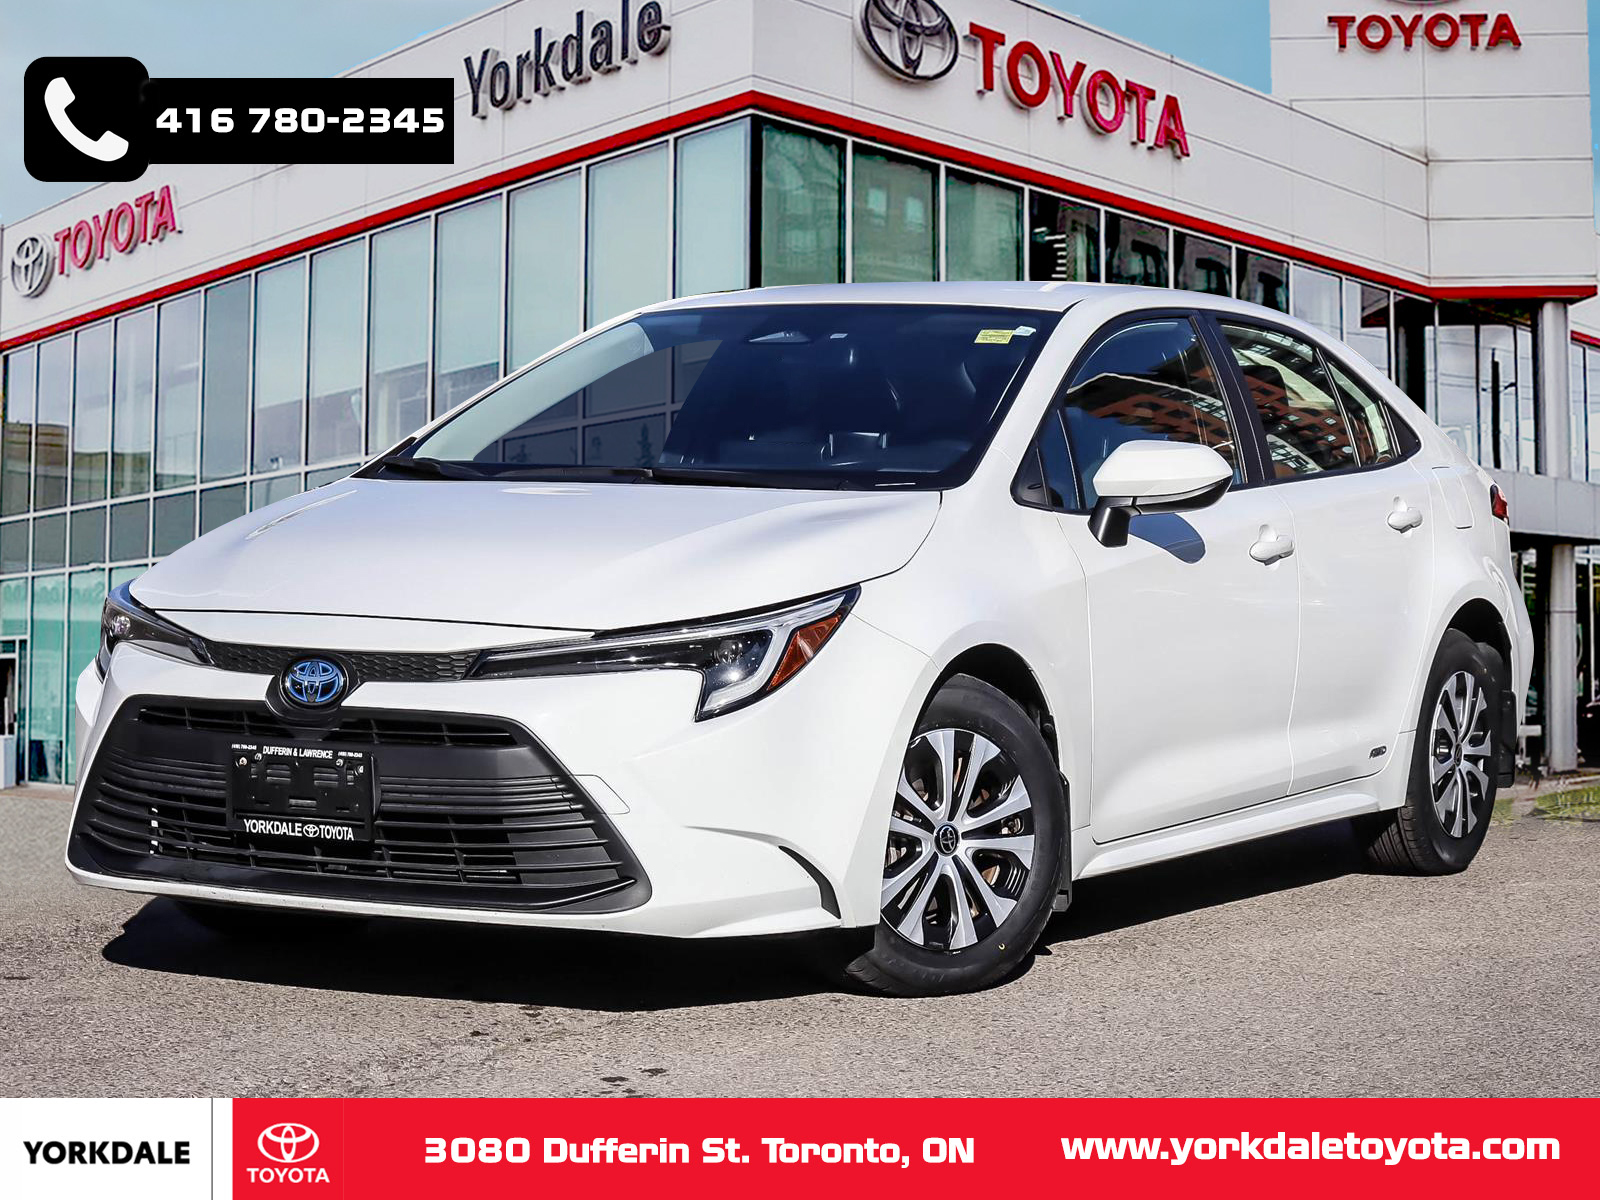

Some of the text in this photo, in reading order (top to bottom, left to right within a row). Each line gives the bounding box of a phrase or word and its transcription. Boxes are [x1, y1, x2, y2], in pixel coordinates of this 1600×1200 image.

[464, 0, 671, 119] Yorkdale
[1327, 13, 1522, 51] TOYOTA
[967, 21, 1190, 158] TOYOTA
[53, 184, 179, 277] TOYOTA
[262, 745, 293, 757] DUFFERIN
[299, 748, 333, 759] LAWRENCE
[243, 818, 355, 841] YORKDALE TOYOTA
